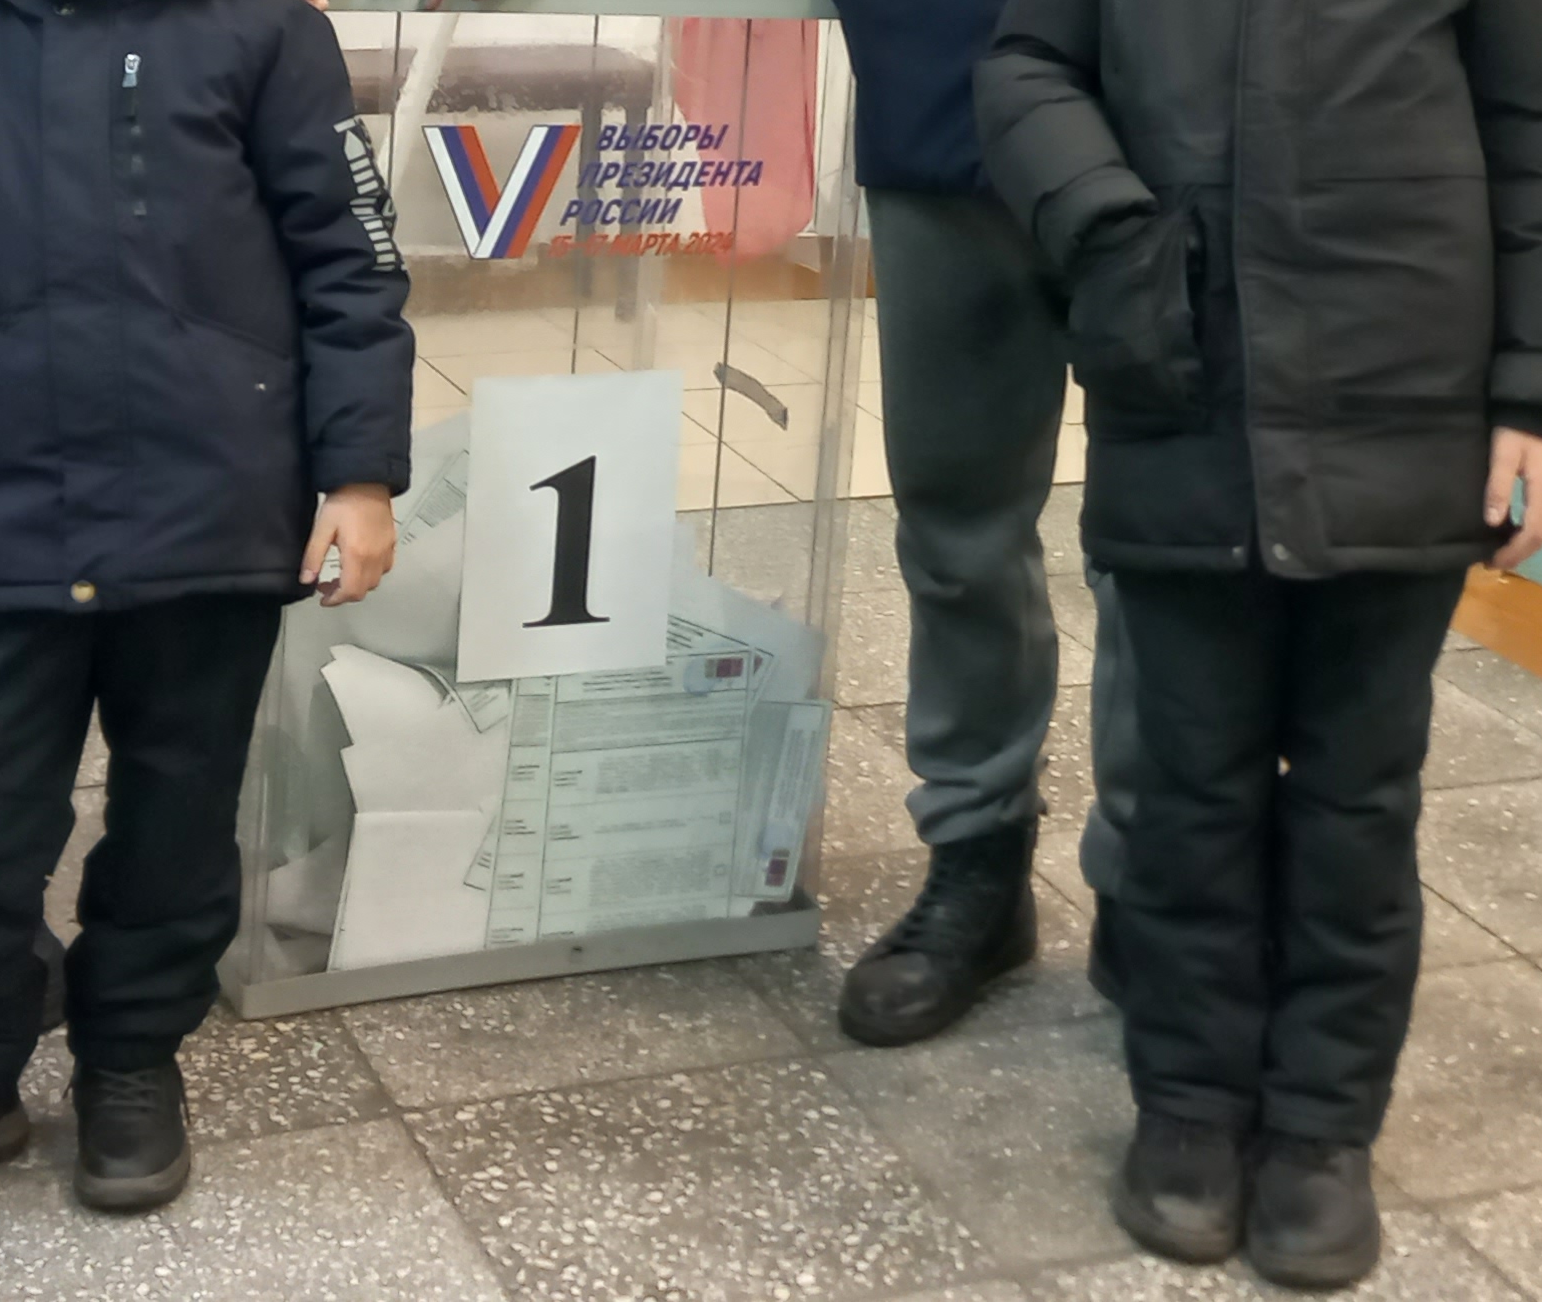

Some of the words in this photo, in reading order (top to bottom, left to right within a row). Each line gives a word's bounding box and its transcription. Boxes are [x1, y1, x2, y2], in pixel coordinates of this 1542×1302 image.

[598, 124, 728, 151] ВЫБОРЫ
[578, 160, 763, 192] ПРЕЗИДЕНТА
[560, 197, 683, 226] РОССИИ
[610, 233, 681, 256] МАРТА
[682, 231, 735, 255] 2024
[522, 455, 610, 628] 1
